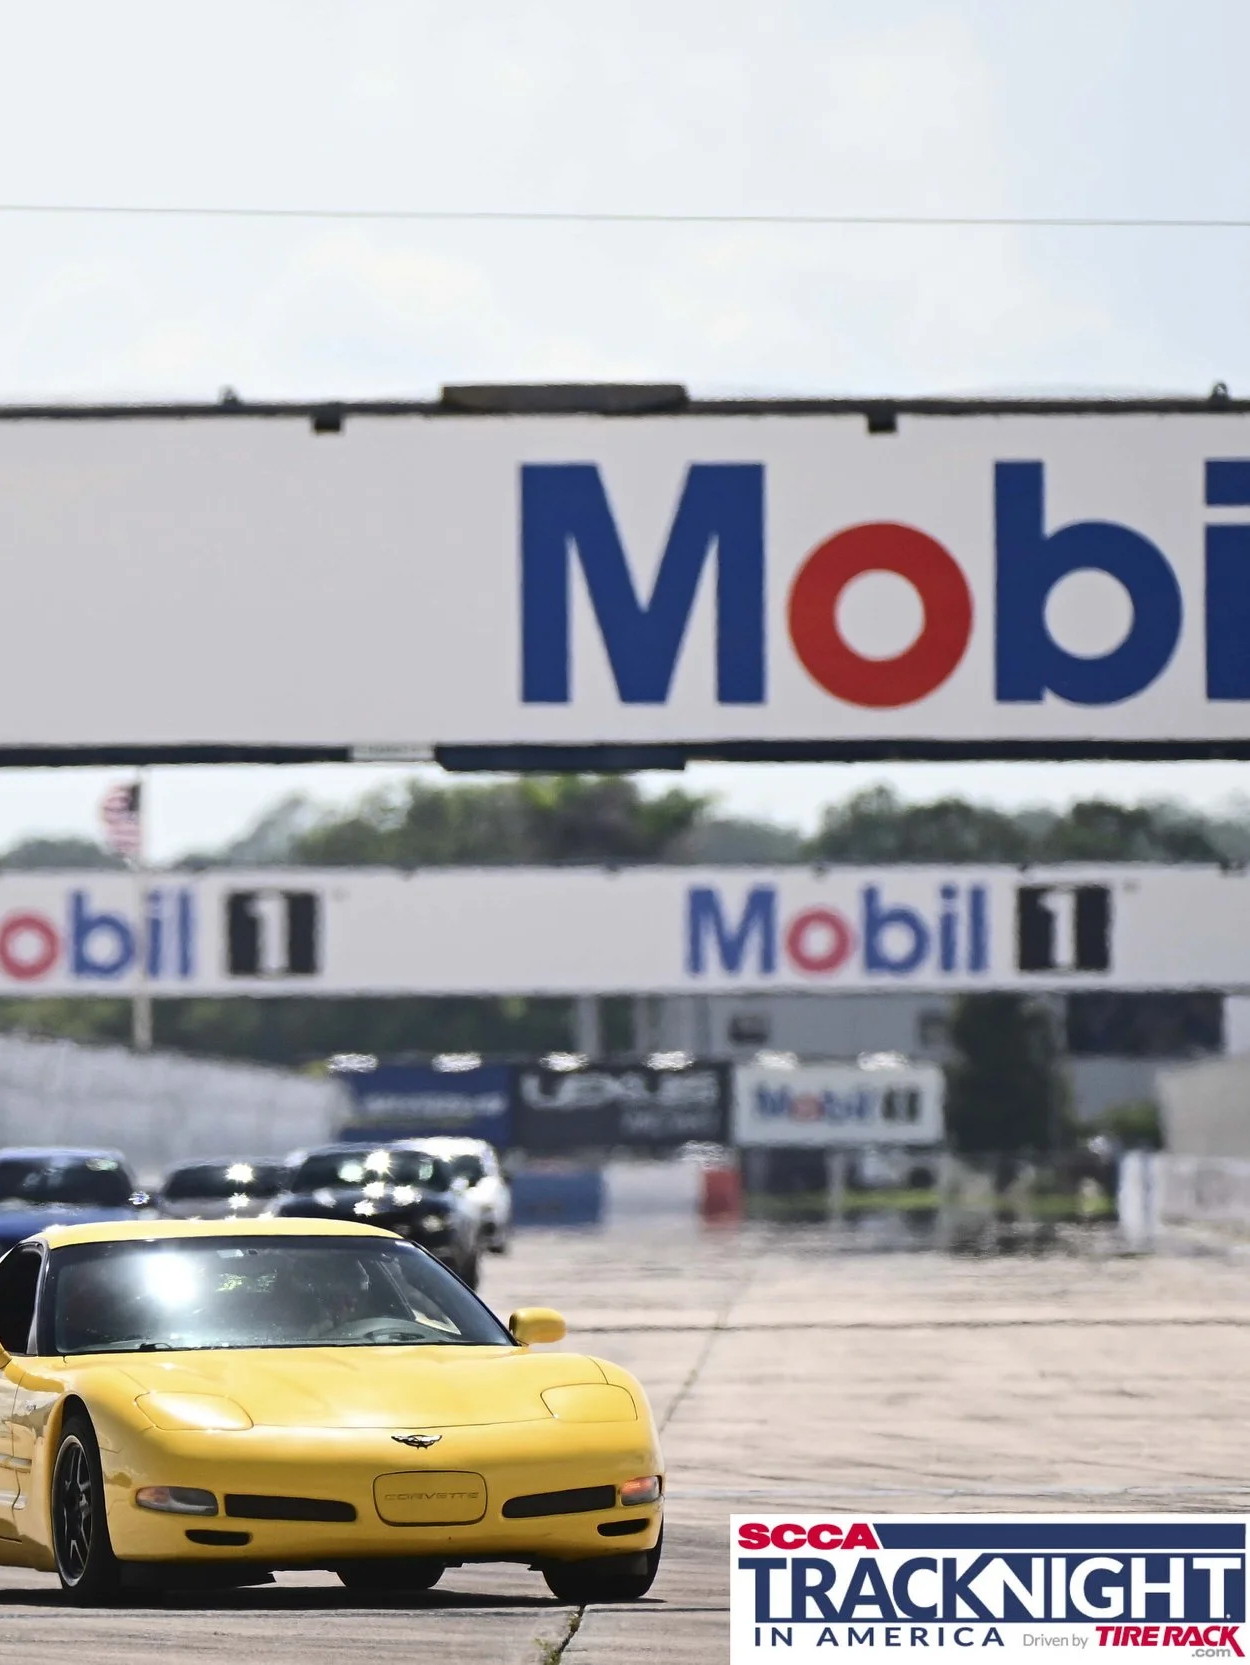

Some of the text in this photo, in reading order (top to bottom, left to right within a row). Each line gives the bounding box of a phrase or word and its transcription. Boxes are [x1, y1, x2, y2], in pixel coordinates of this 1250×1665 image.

[249, 890, 286, 974] 1
[686, 883, 1075, 975] Mobil 1
[384, 1491, 479, 1501] CORVETTE
